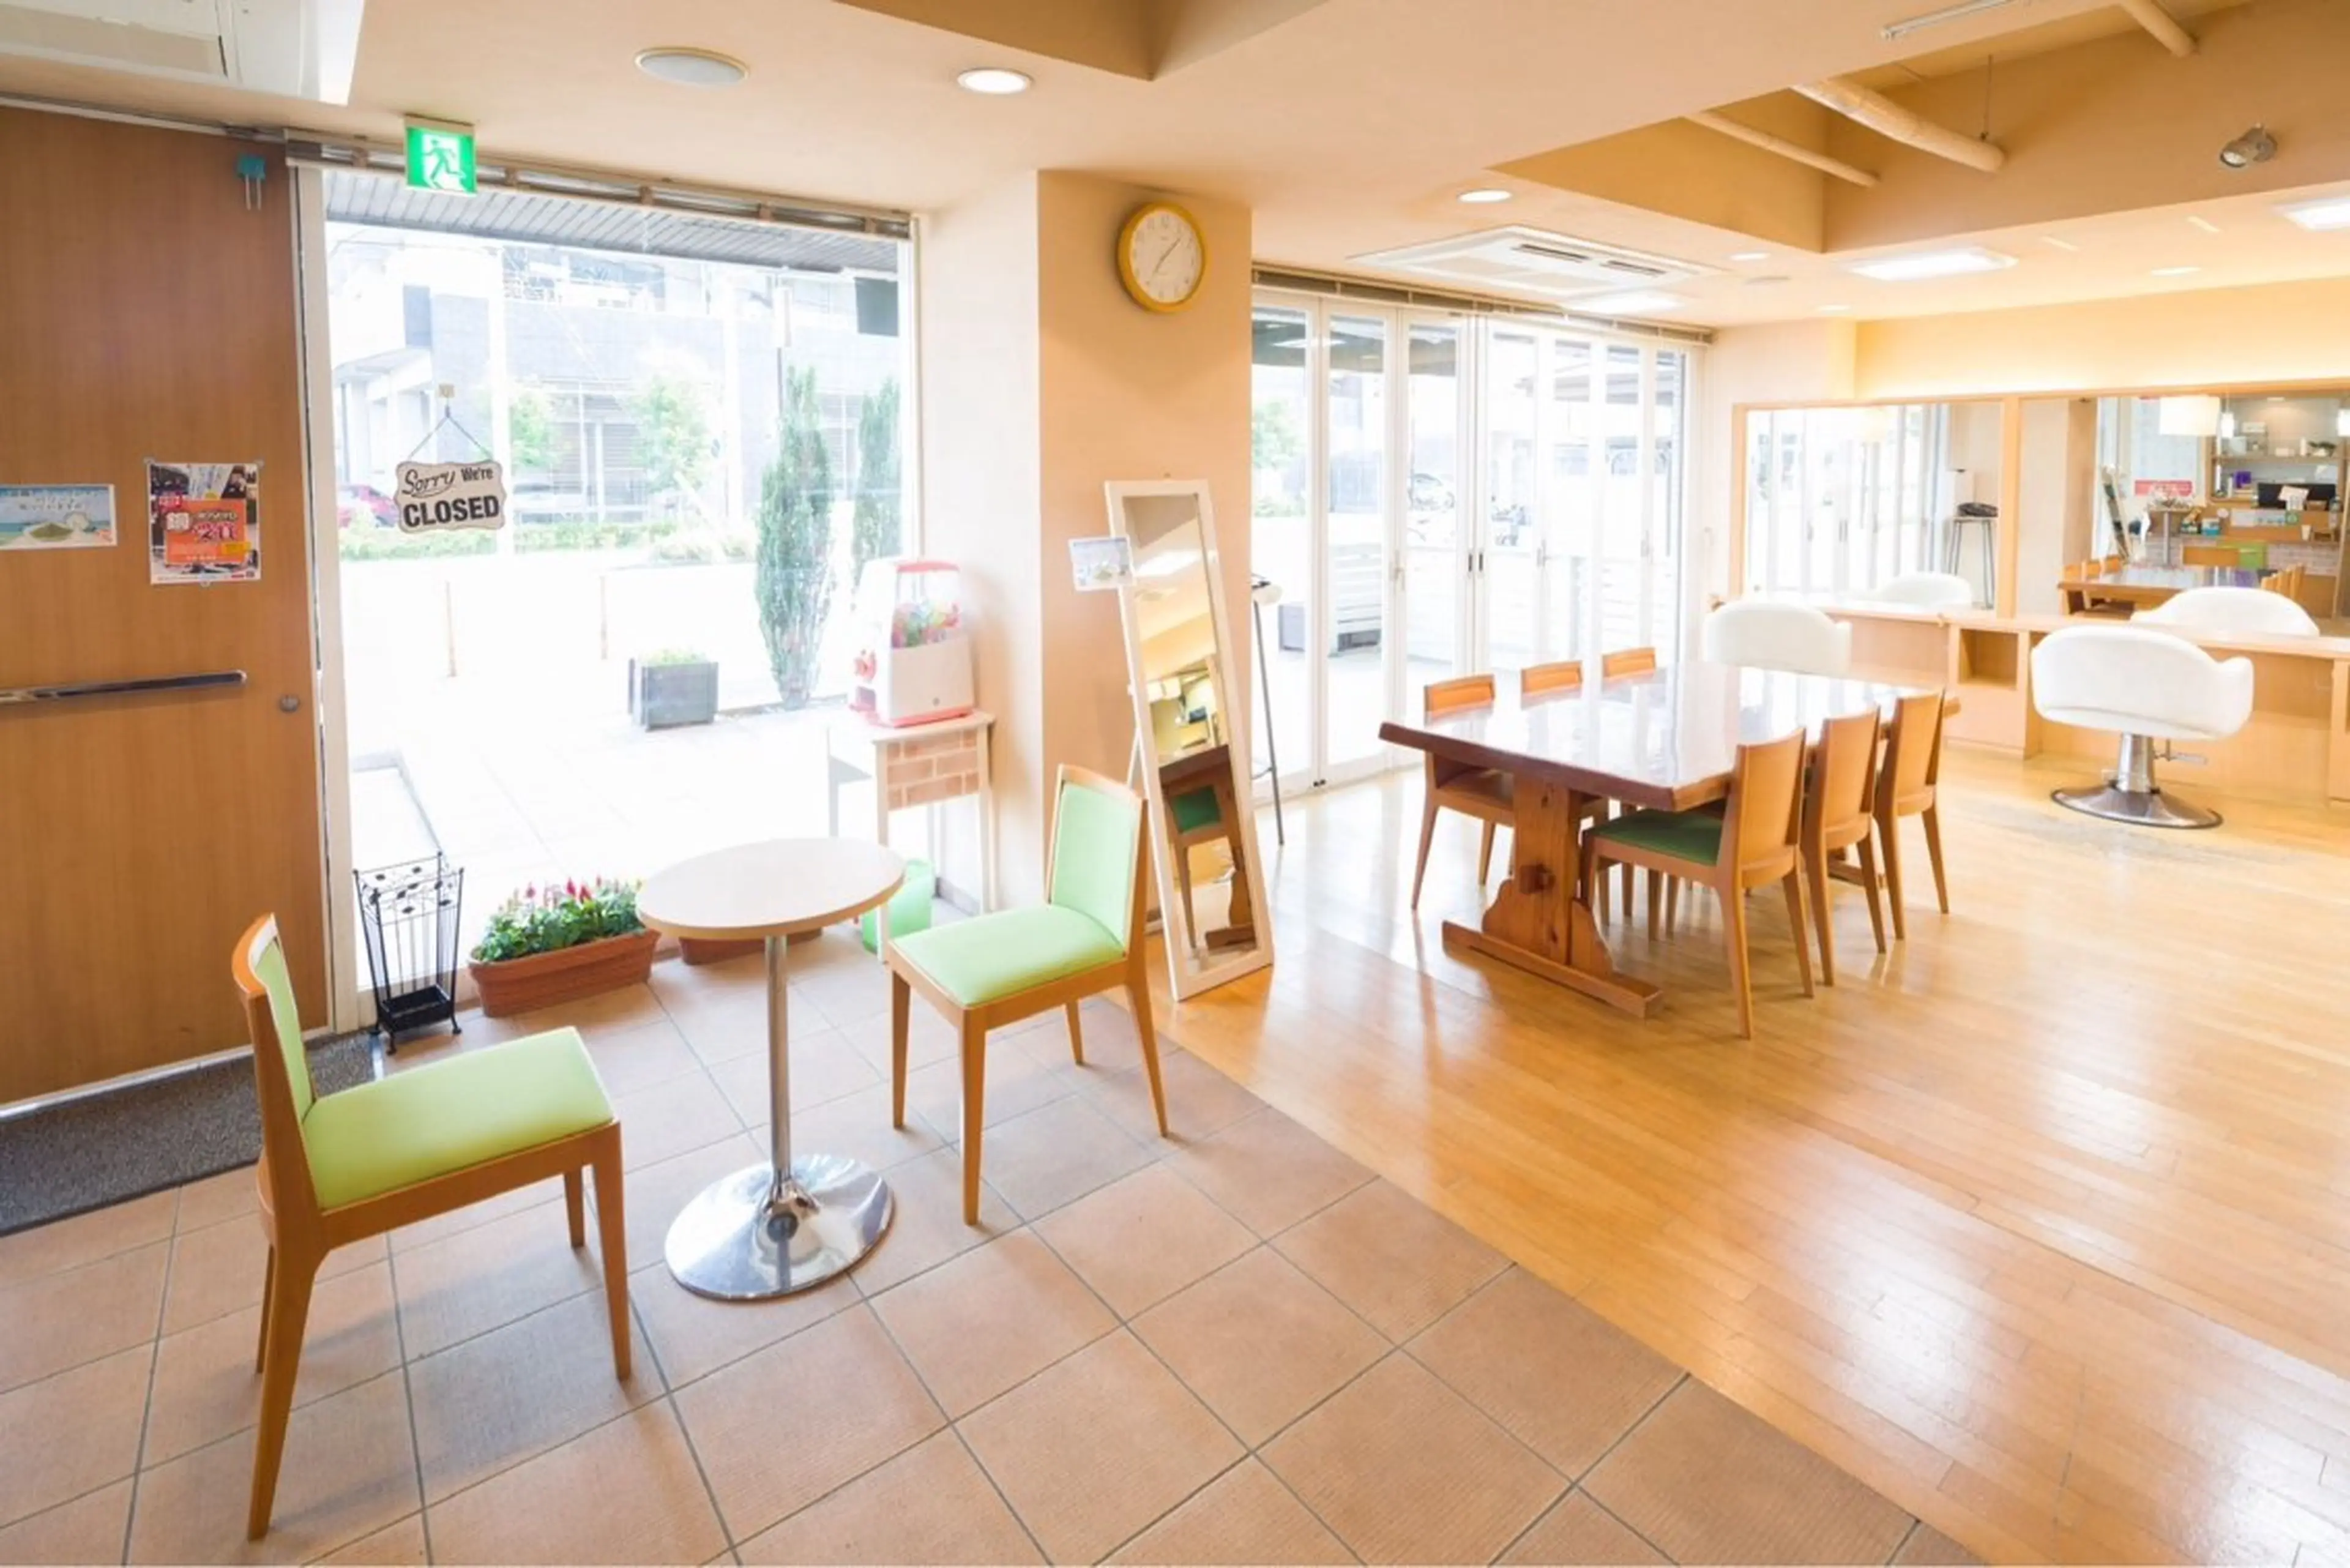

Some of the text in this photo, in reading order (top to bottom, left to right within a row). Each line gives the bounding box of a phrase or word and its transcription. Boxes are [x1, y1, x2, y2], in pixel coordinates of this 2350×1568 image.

[401, 467, 494, 498] Sorry We're
[403, 495, 499, 528] CLOSED
